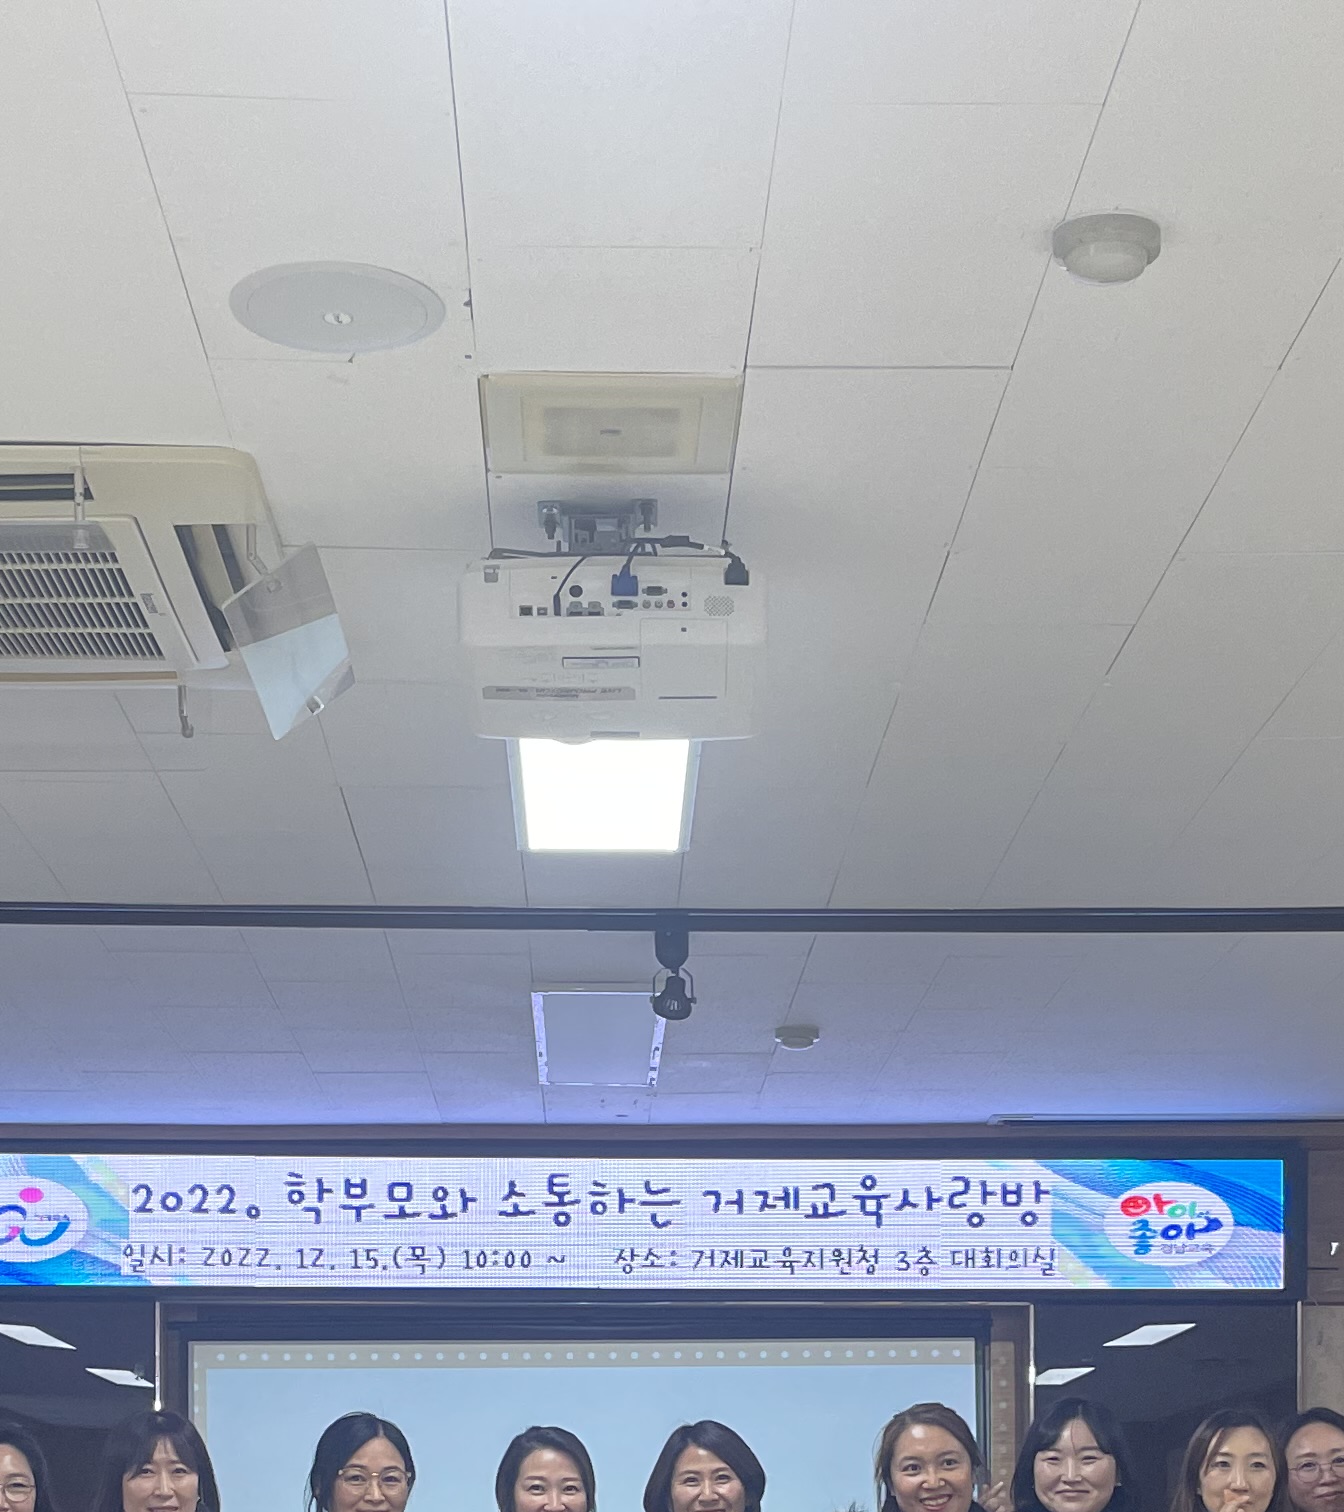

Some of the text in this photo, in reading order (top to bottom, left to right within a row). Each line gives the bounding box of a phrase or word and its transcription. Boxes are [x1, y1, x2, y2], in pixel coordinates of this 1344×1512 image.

[283, 1171, 478, 1225] 학부모와
[498, 1173, 682, 1229] 소통하는
[702, 1174, 1051, 1228] 거제교육사랑방
[122, 1243, 187, 1274] 일시:
[201, 1246, 282, 1271] 2022.
[296, 1247, 336, 1271] 12.
[462, 1249, 532, 1270] 10:00
[613, 1247, 678, 1275] 장소:
[690, 1244, 880, 1276] 거제교육지원청
[894, 1245, 938, 1276] 3층
[950, 1246, 1056, 1276] 대회의실
